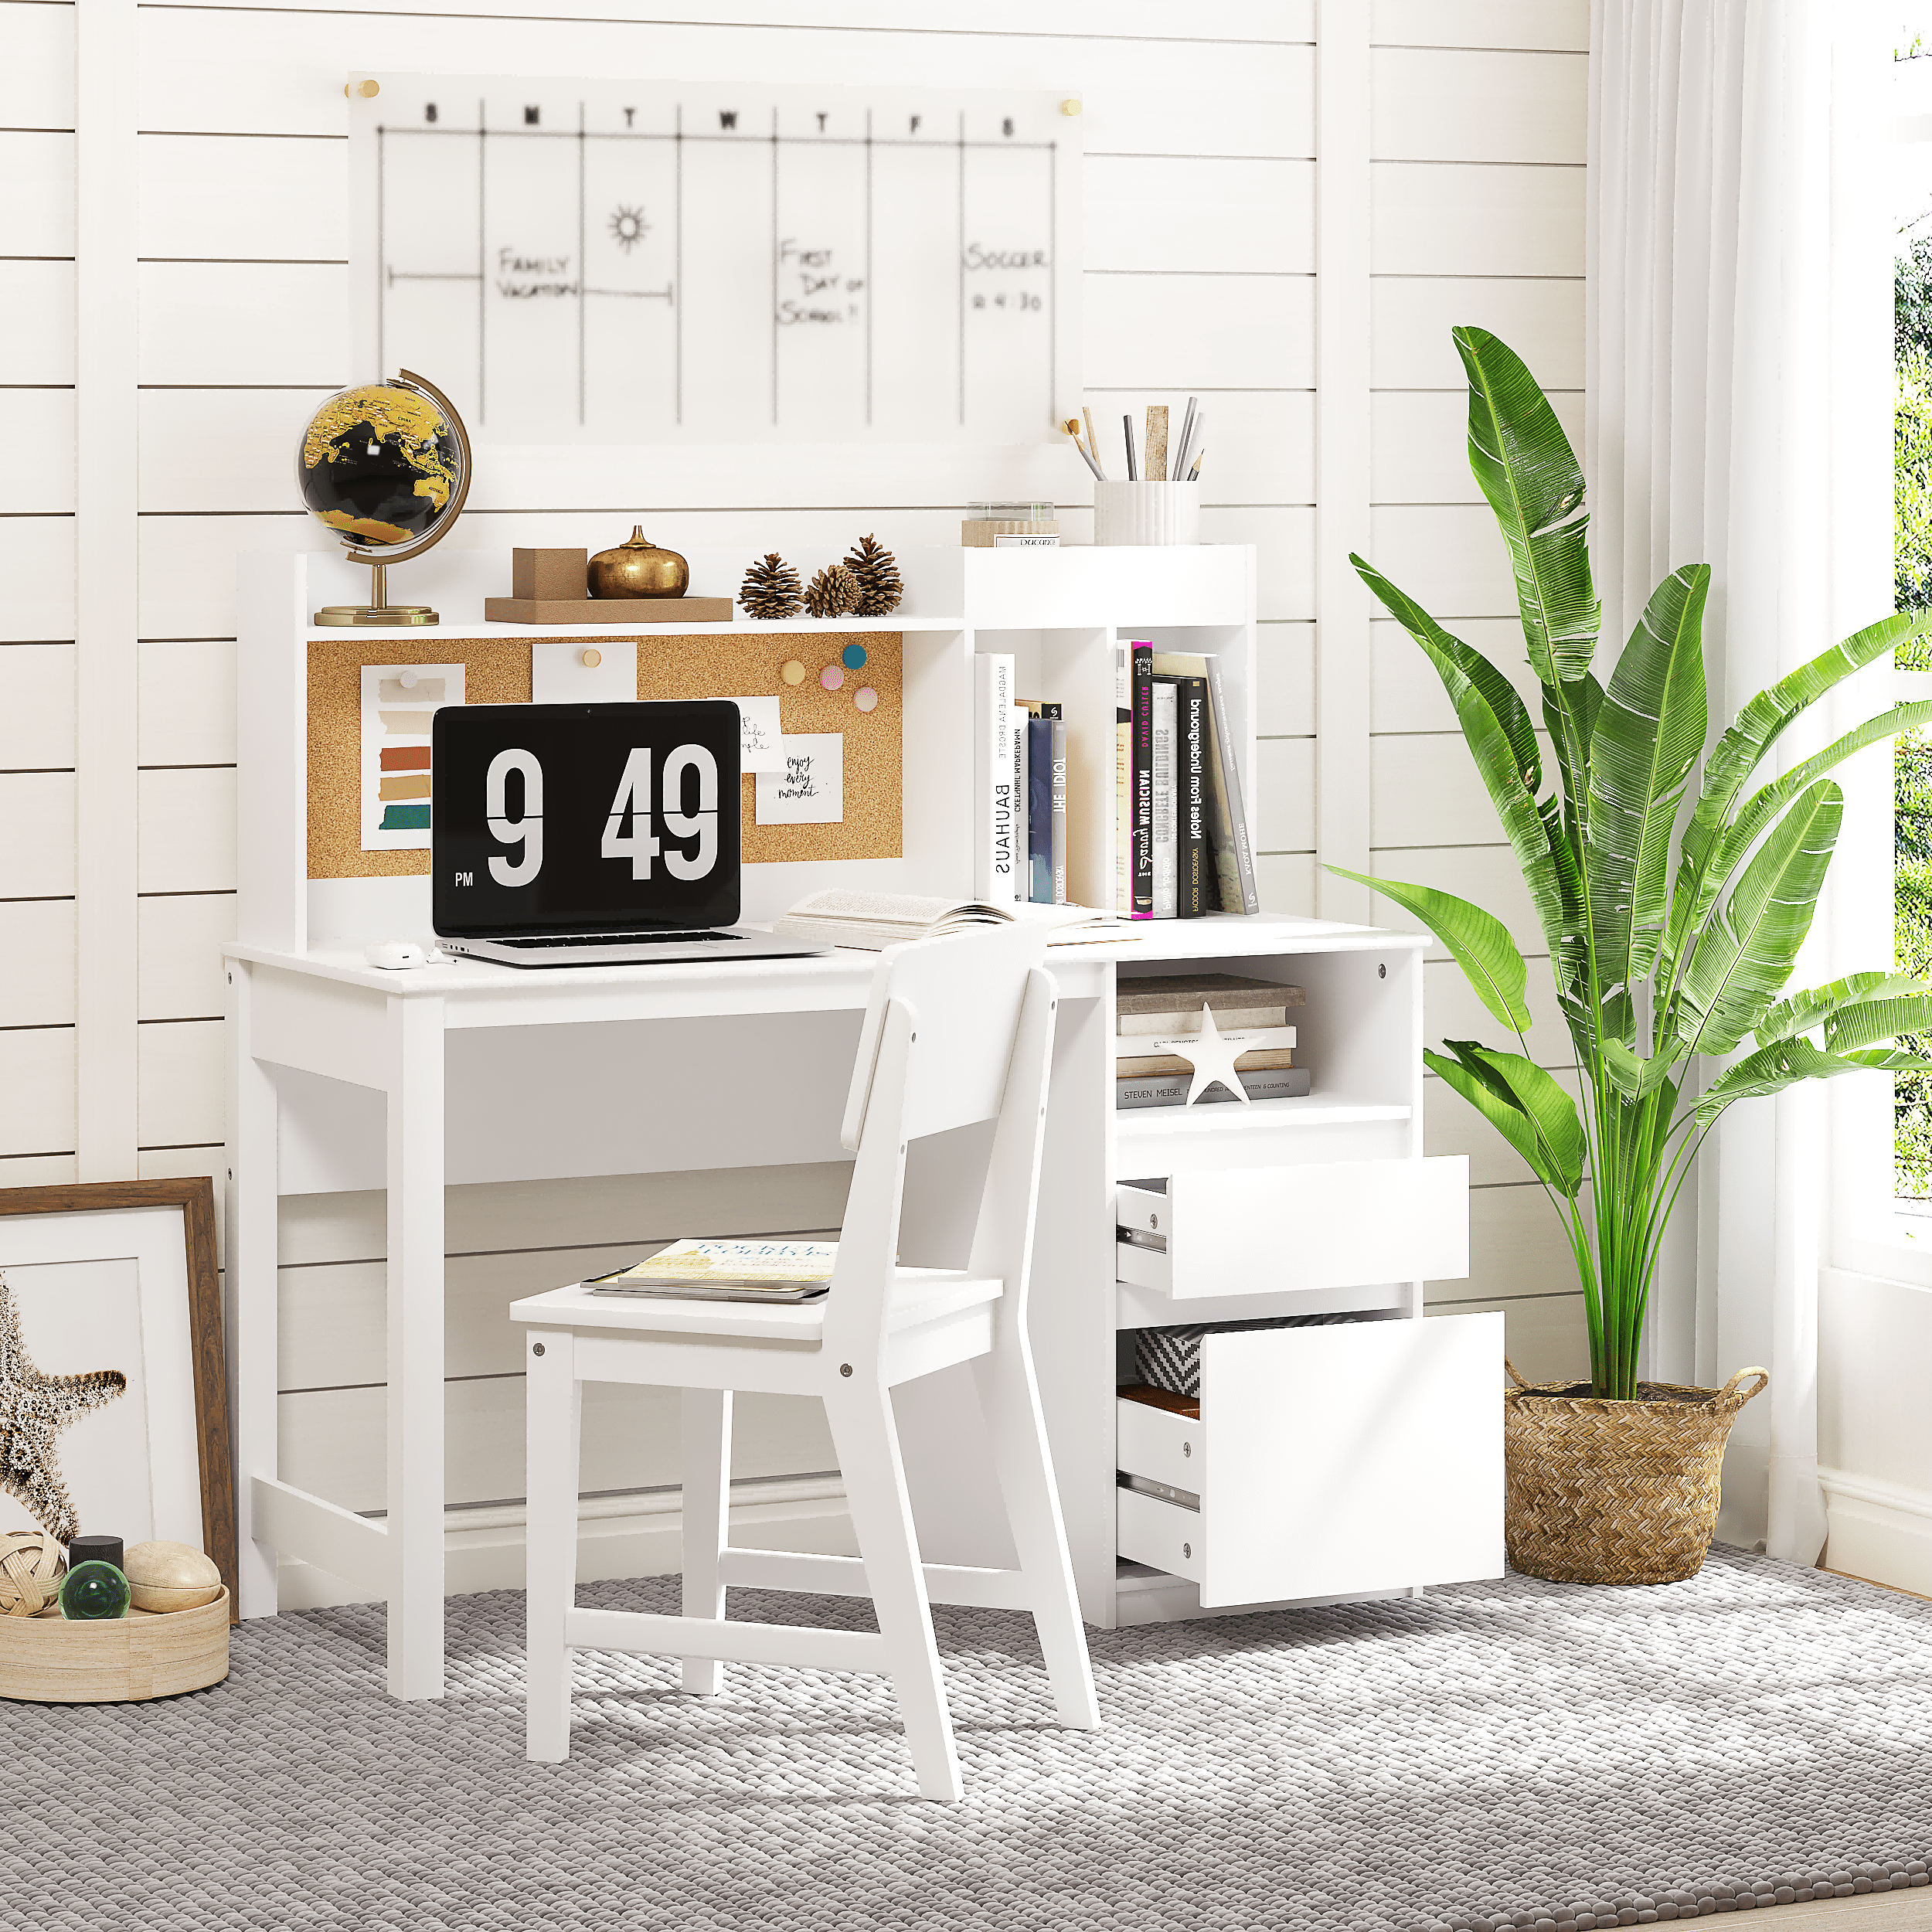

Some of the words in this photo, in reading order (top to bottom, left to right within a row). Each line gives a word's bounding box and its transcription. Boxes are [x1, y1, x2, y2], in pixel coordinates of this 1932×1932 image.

[524, 106, 540, 124] M
[622, 107, 635, 128] T
[719, 111, 736, 130] W
[816, 111, 828, 133] T
[909, 115, 921, 134] F
[787, 757, 815, 774] enjoy
[784, 773, 815, 788] every
[778, 784, 818, 798] moment
[486, 748, 543, 887] 9
[601, 743, 718, 881] 49
[455, 872, 473, 886] PM
[1124, 1088, 1152, 1099] STEVEN
[1156, 1086, 1182, 1097] MEISEL
